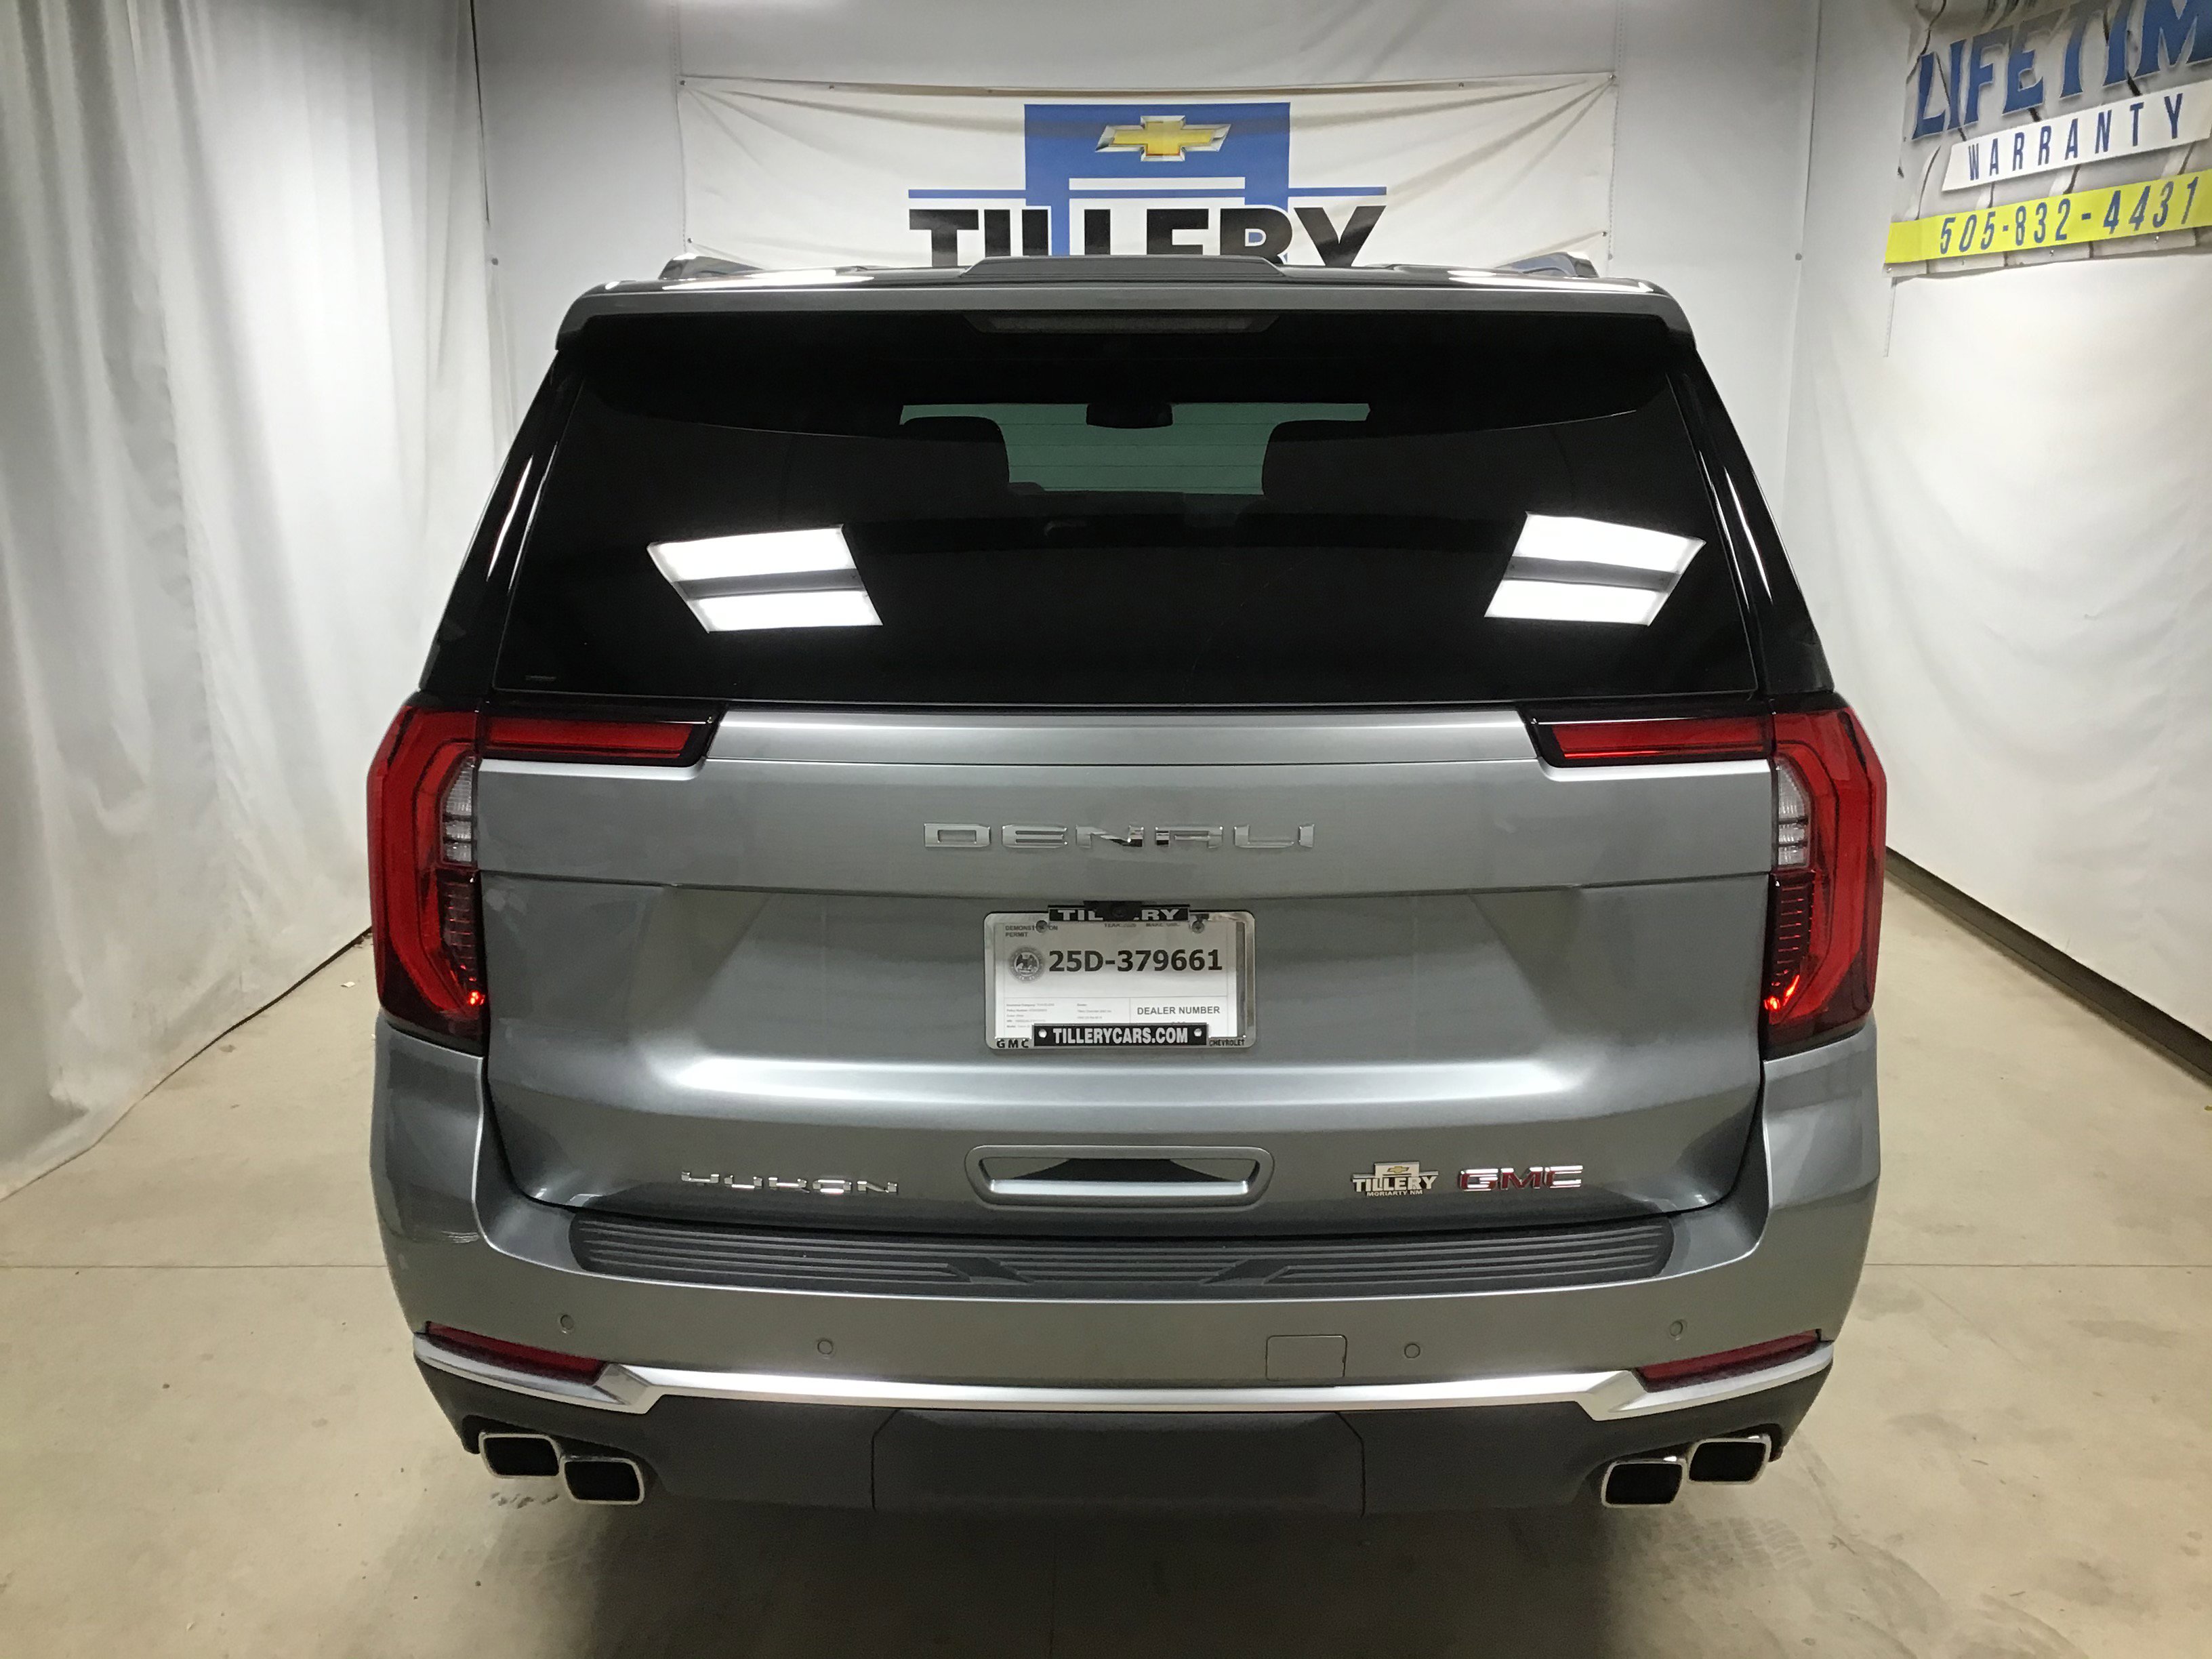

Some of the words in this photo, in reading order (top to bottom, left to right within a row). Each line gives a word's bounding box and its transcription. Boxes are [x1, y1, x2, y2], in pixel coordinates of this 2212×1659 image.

[1968, 93, 2183, 181] WARRANTY
[1940, 177, 2198, 254] 505-832-4431
[924, 823, 1314, 848] DENALI
[1058, 909, 1179, 921] TILRY
[1048, 949, 1222, 972] 25D-379661
[1179, 1006, 1220, 1014] NUMBER
[1053, 1027, 1188, 1044] TILLERYCARS.COM
[1353, 1176, 1437, 1192] TILLERY
[1459, 1165, 1584, 1191] GMC
